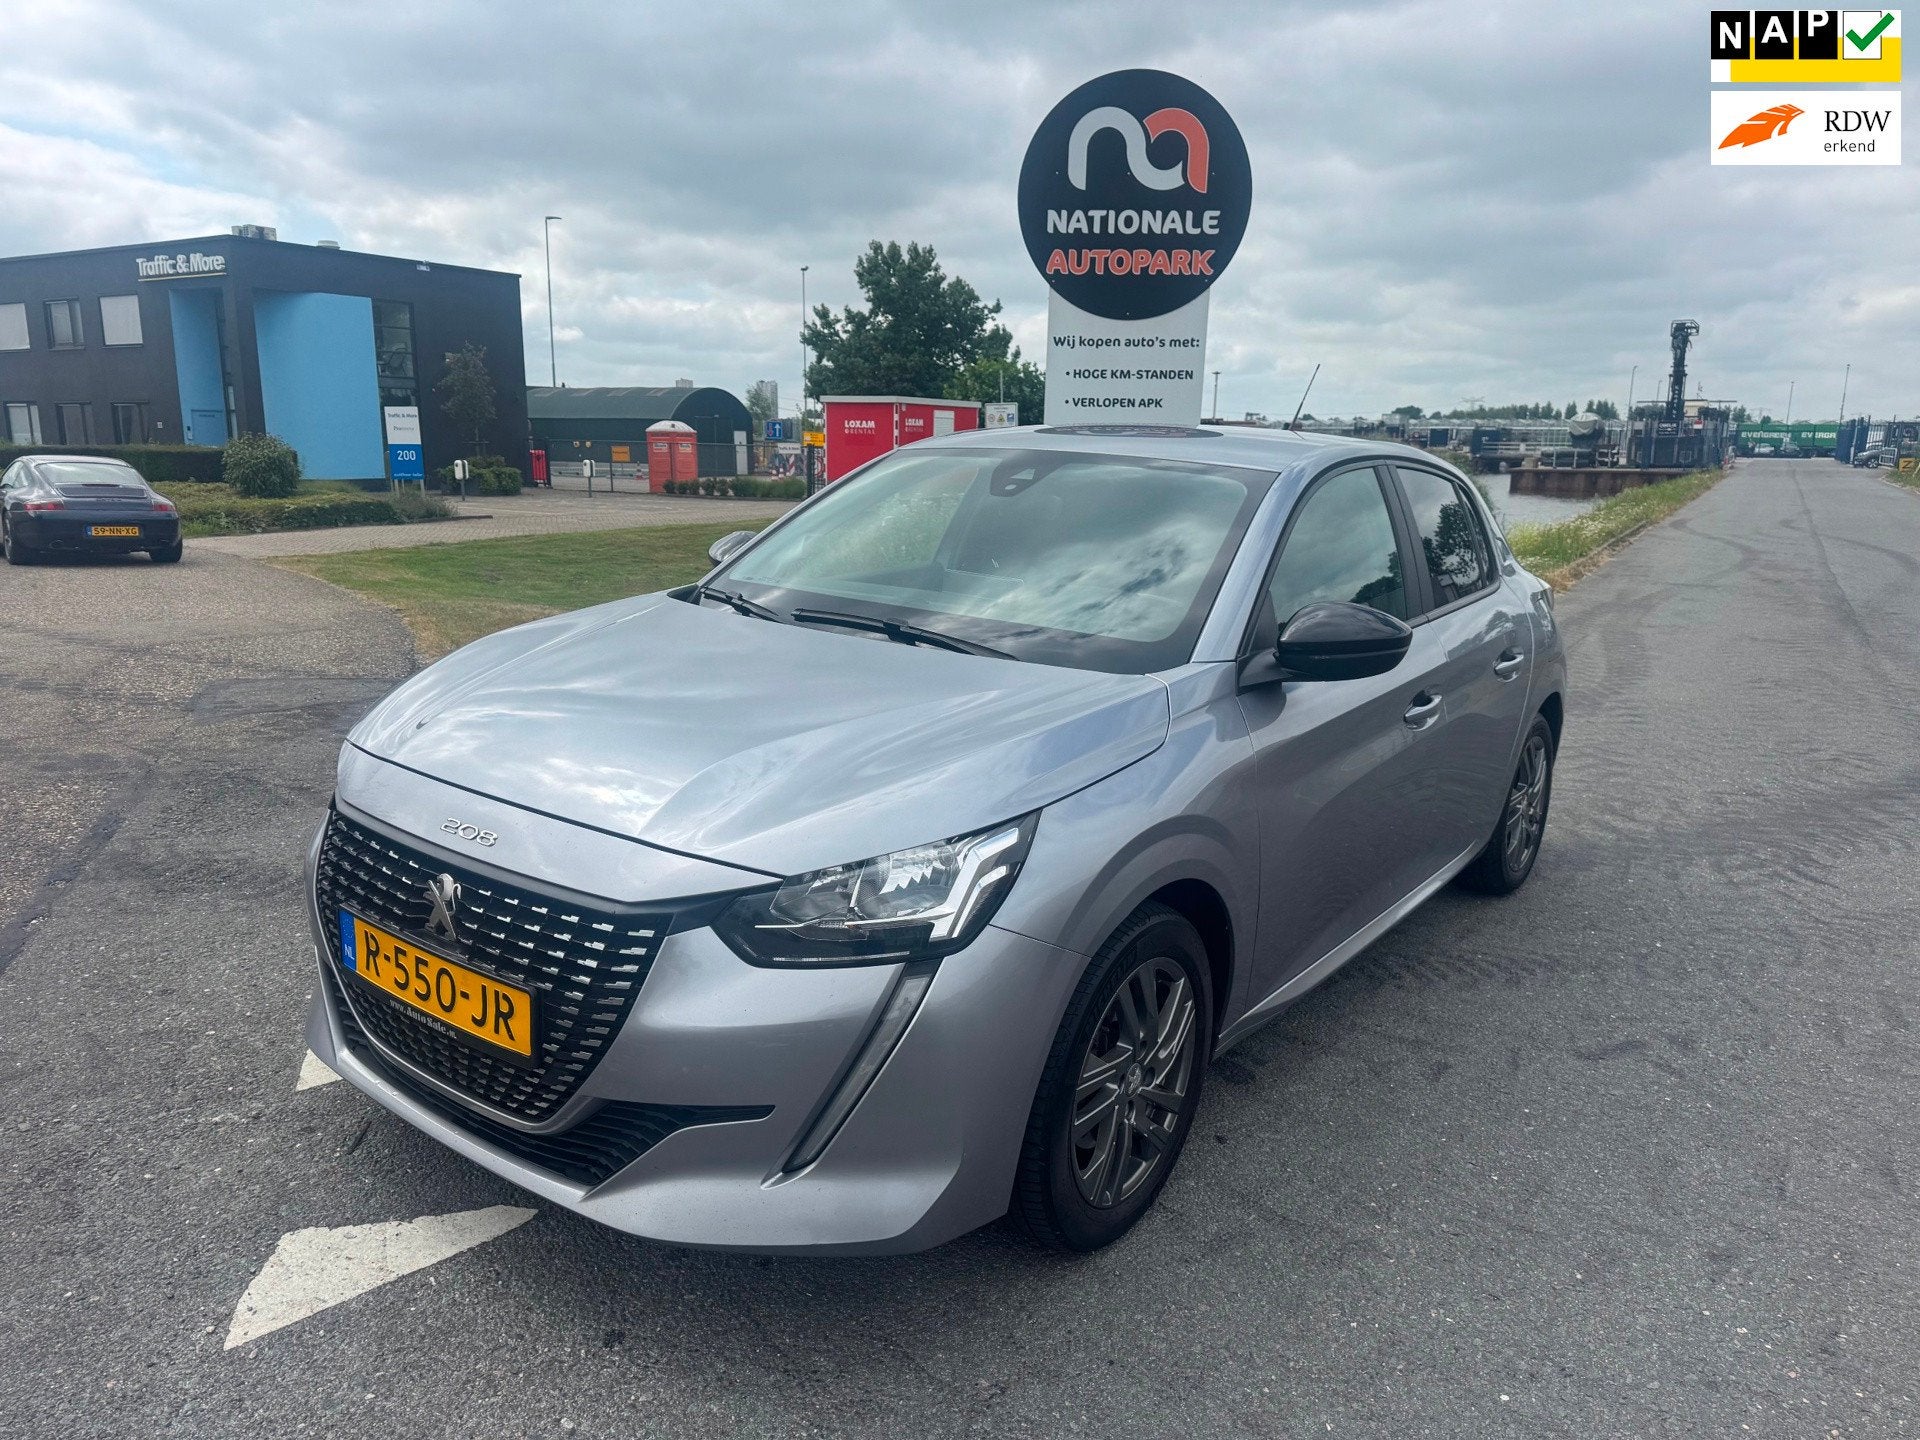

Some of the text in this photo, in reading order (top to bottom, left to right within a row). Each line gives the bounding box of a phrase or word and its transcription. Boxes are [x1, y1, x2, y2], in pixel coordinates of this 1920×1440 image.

[1046, 209, 1221, 235] NATIONALE
[136, 252, 226, 276] Traffic & More
[1046, 249, 1216, 275] AUTOPARK
[1053, 335, 1200, 349] Wij kopen auto's met:
[1073, 369, 1194, 380] HOGE KM-STANDEN
[1072, 398, 1163, 408] VERLOPEN APK
[844, 420, 876, 428] LOXAM
[905, 418, 924, 426] LOXAM
[397, 450, 416, 461] 200
[93, 527, 137, 535] 59-NN-XG
[440, 817, 499, 847] 208
[363, 929, 516, 1042] R-550-JR
